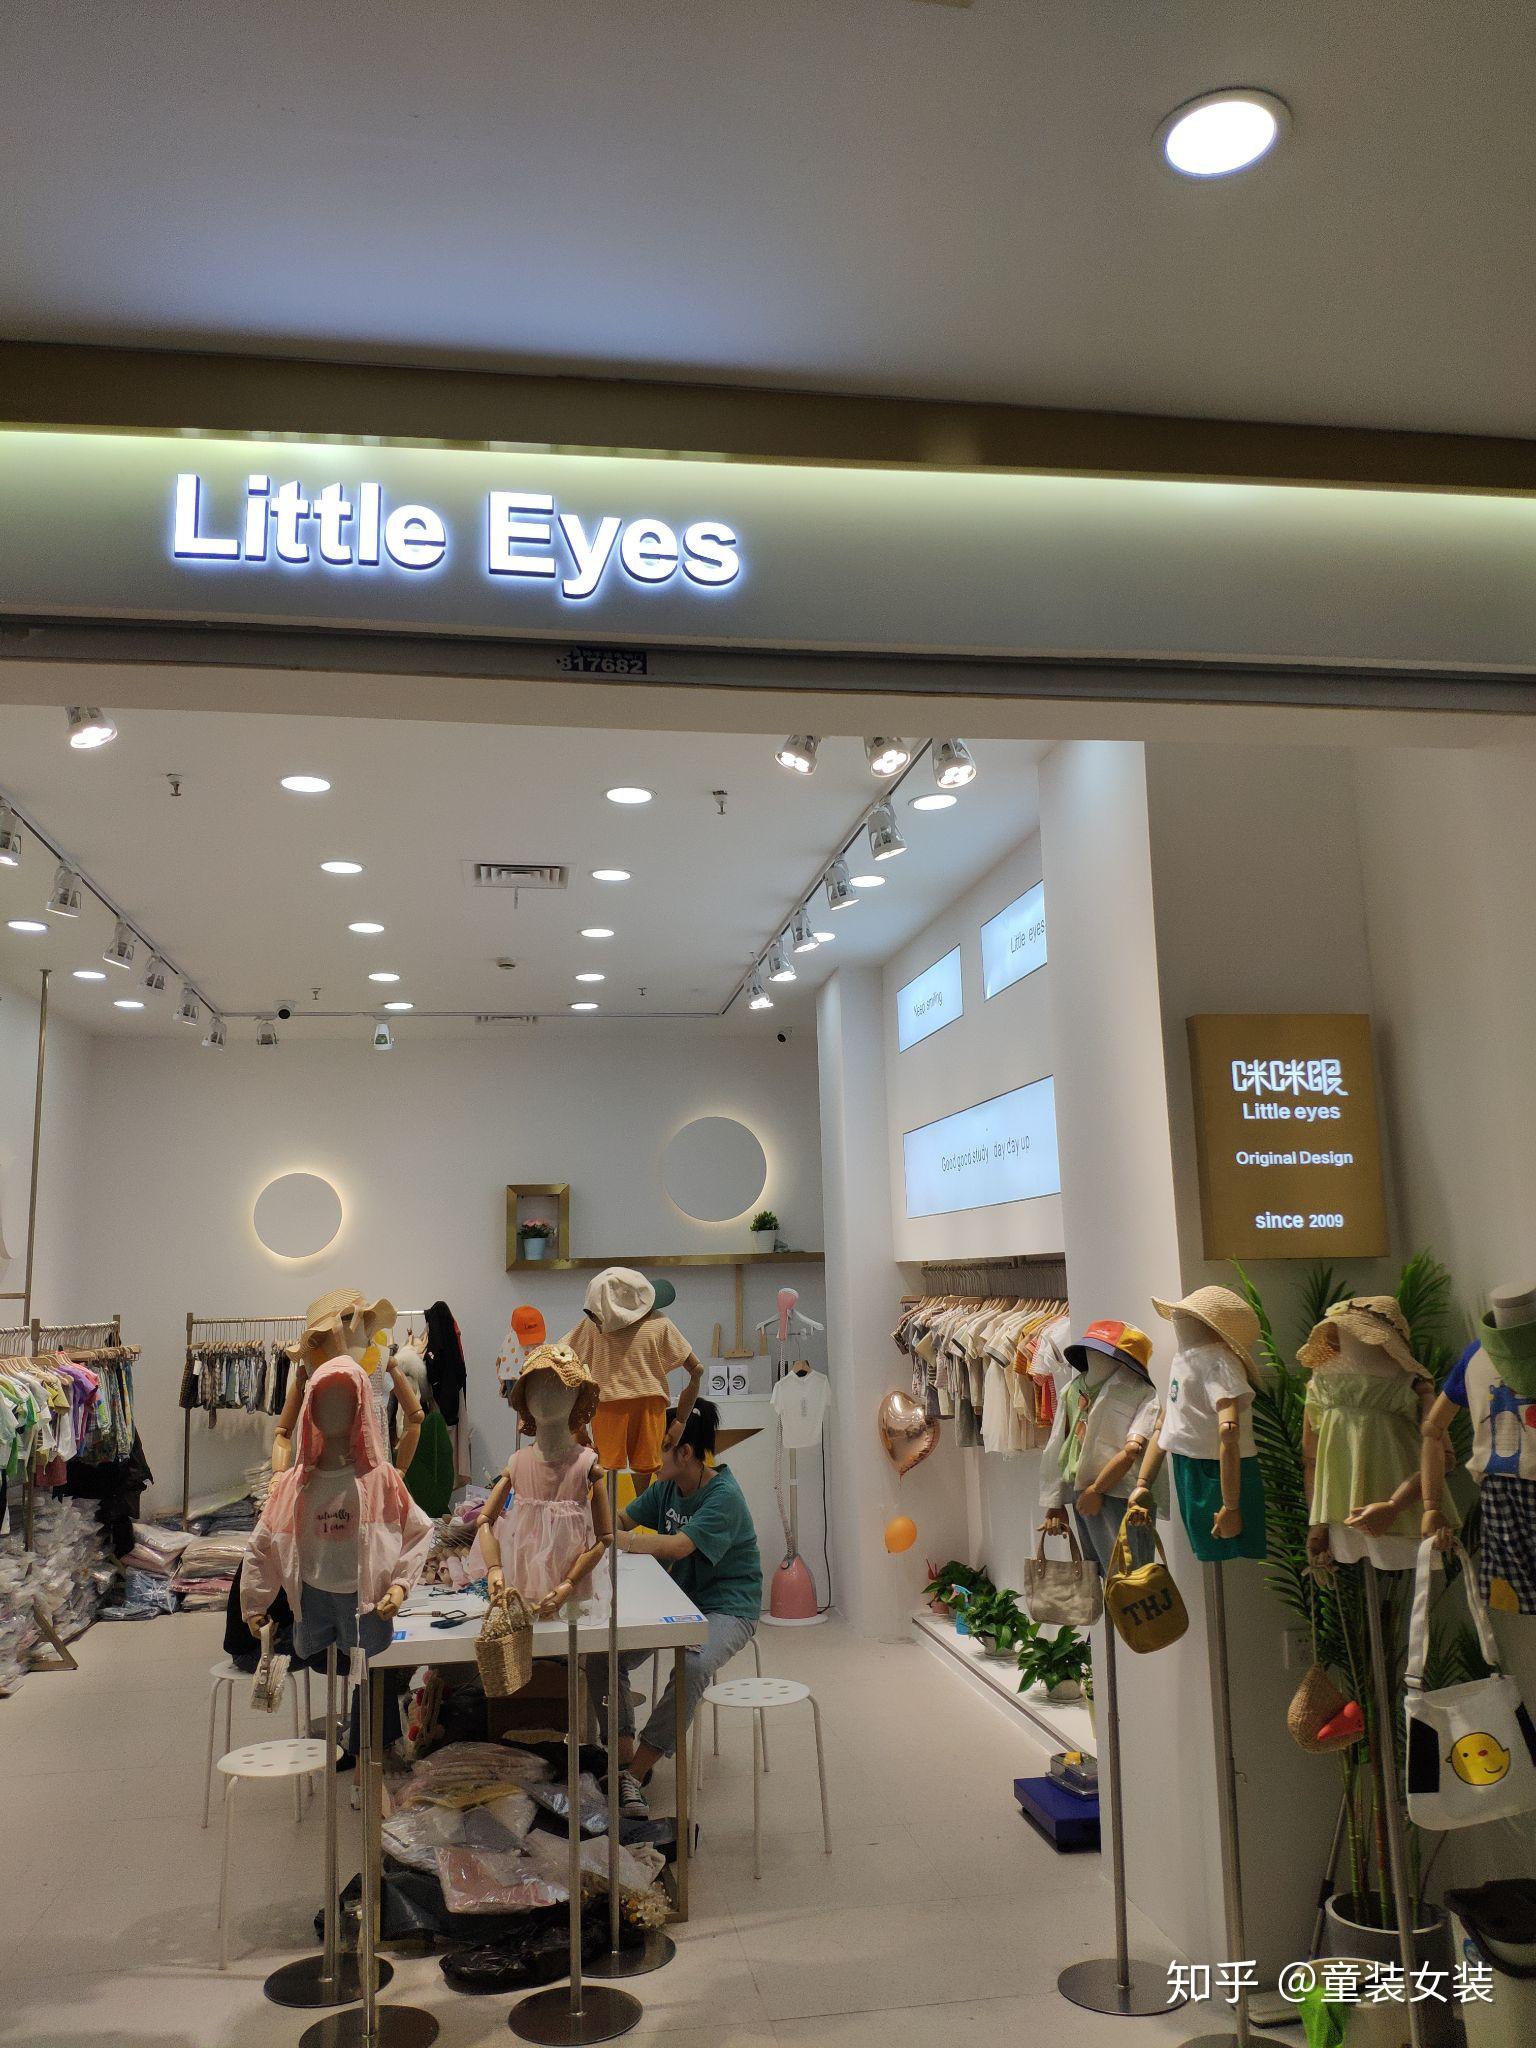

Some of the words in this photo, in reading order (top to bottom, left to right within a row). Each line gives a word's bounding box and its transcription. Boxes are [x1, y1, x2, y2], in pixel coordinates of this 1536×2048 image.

[174, 473, 446, 570] Little
[488, 491, 740, 600] Eyes
[1028, 919, 1045, 943] eyes
[1242, 1102, 1291, 1120] Little
[1294, 1104, 1342, 1122] eyes
[993, 1141, 1006, 1160] day
[1006, 1136, 1020, 1156] day
[1021, 1135, 1031, 1152] up
[1235, 1151, 1297, 1167] Original
[1300, 1151, 1354, 1167] Design
[1255, 1212, 1304, 1229] since
[1309, 1214, 1344, 1228] 2009
[1121, 1587, 1174, 1626] THJ
